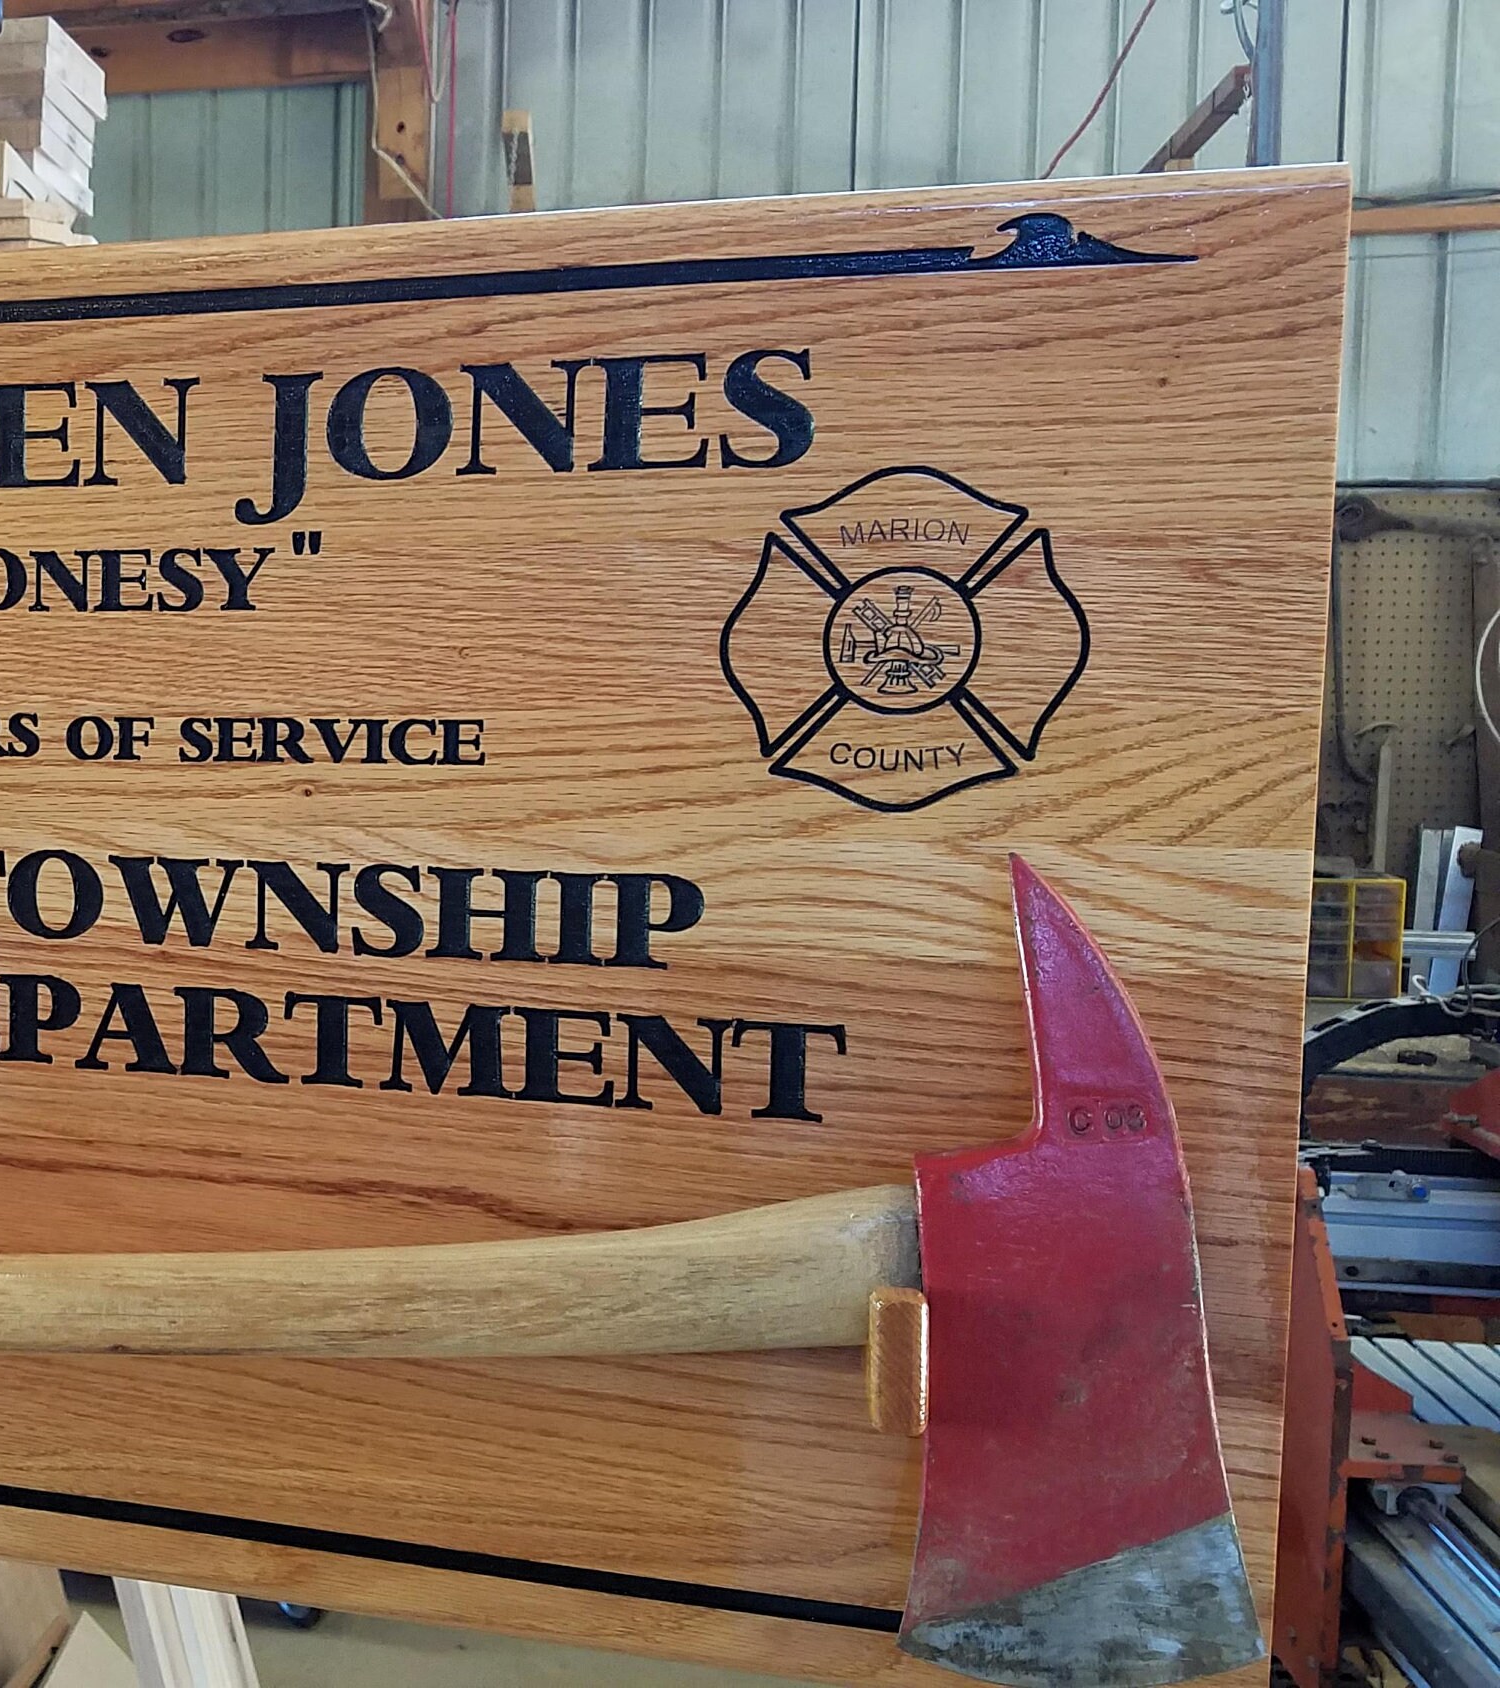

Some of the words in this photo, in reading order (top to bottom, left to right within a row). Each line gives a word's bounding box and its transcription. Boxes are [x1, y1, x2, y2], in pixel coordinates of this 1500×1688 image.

[235, 349, 813, 525] JONES
[839, 518, 970, 546] MARION
[67, 716, 154, 761] OF
[179, 718, 485, 765] SERVICE
[829, 741, 966, 772] COUNTY
